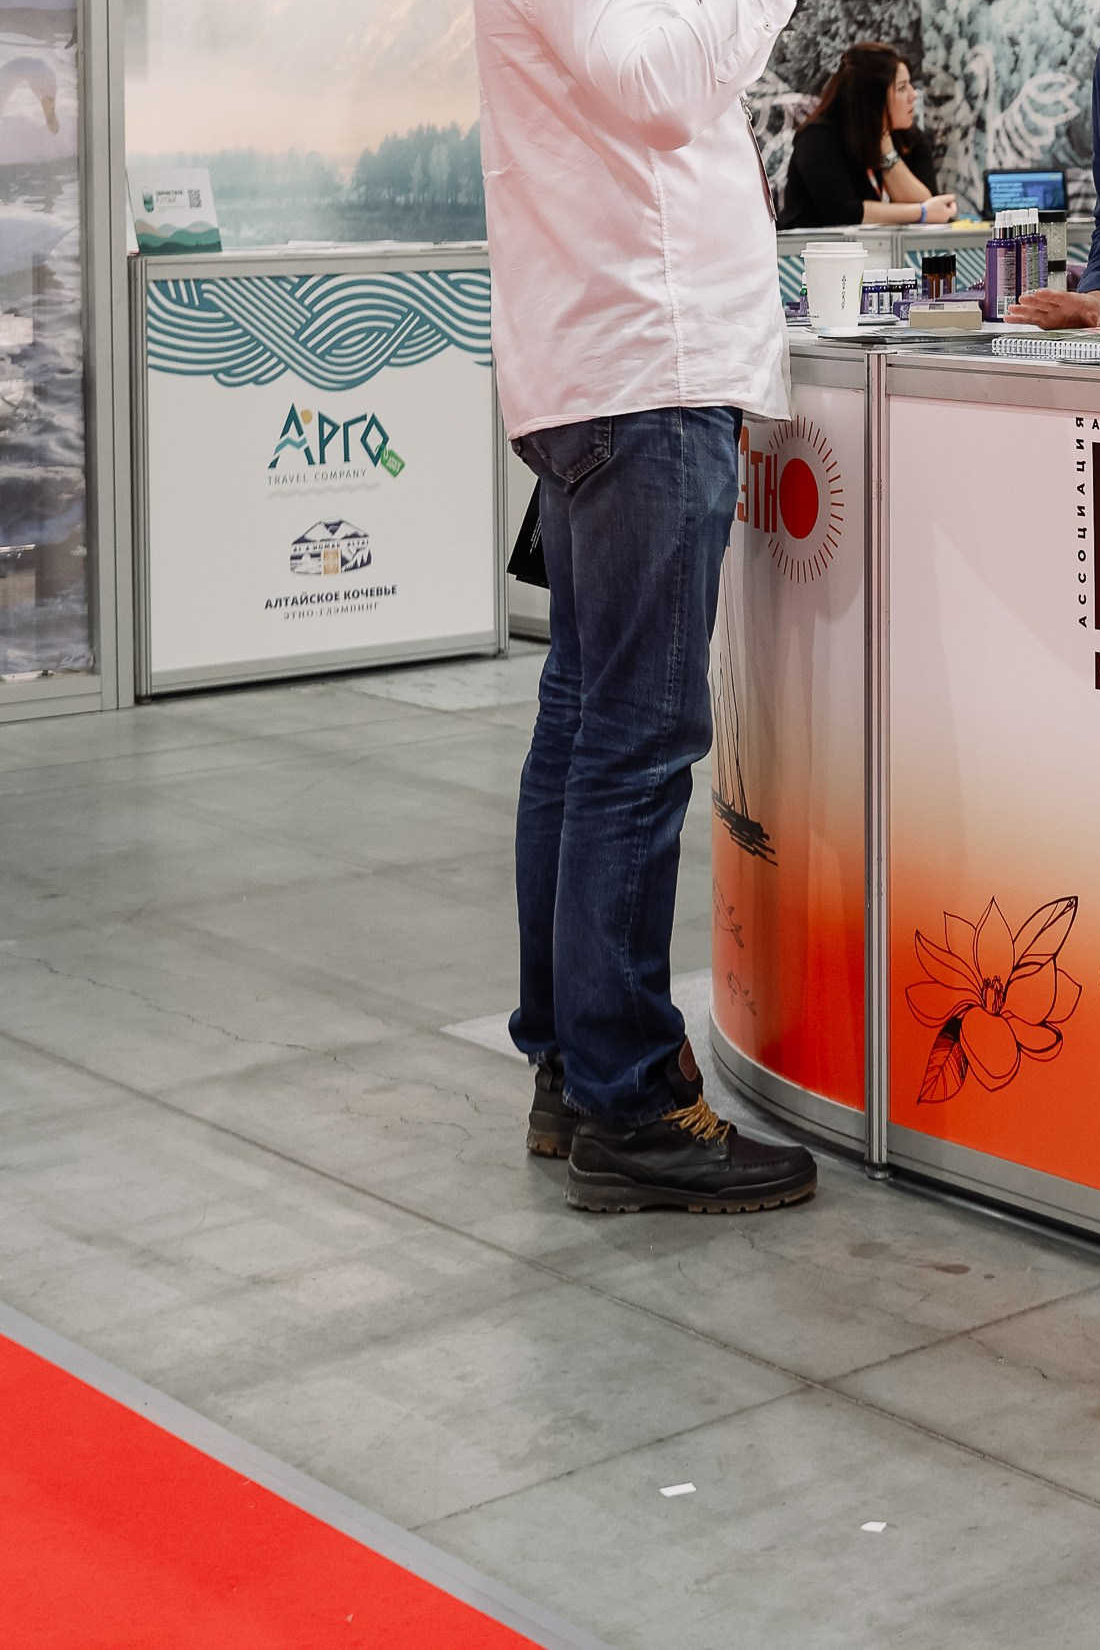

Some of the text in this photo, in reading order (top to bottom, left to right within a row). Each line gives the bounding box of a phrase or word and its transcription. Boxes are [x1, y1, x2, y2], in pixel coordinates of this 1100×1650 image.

[268, 469, 367, 486] TRAVEL COMPANY
[1075, 417, 1088, 628] АССОЦИАЦИЯ
[265, 585, 397, 609] АЛТАЙСКОЕ КОЧЕВЬЕ
